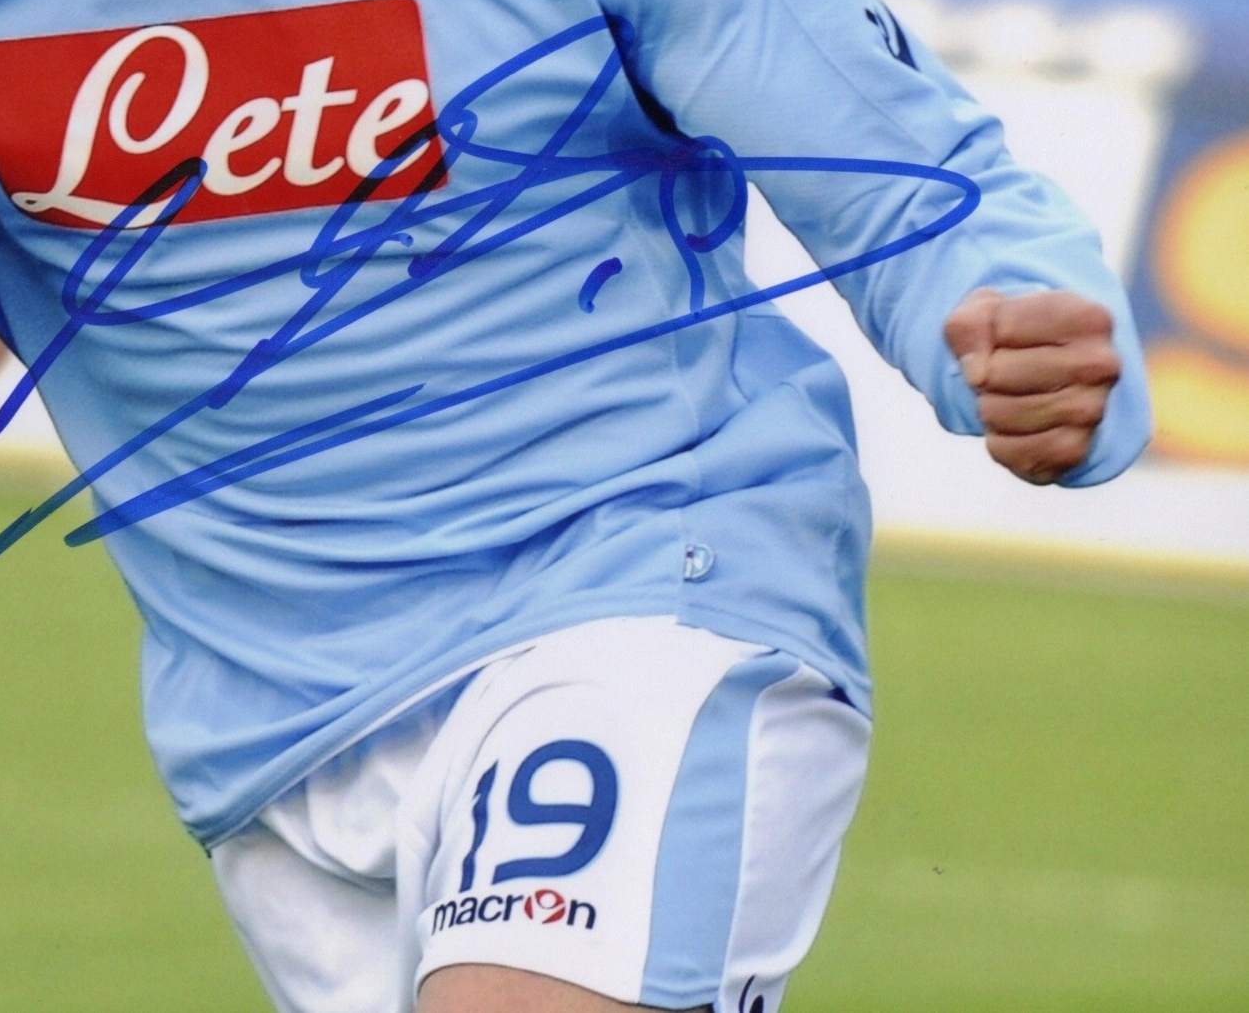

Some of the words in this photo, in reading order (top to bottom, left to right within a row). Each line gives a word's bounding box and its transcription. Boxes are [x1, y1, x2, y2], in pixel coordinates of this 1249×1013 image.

[10, 23, 431, 229] Lete
[458, 738, 619, 893] 19
[431, 888, 597, 936] macron
